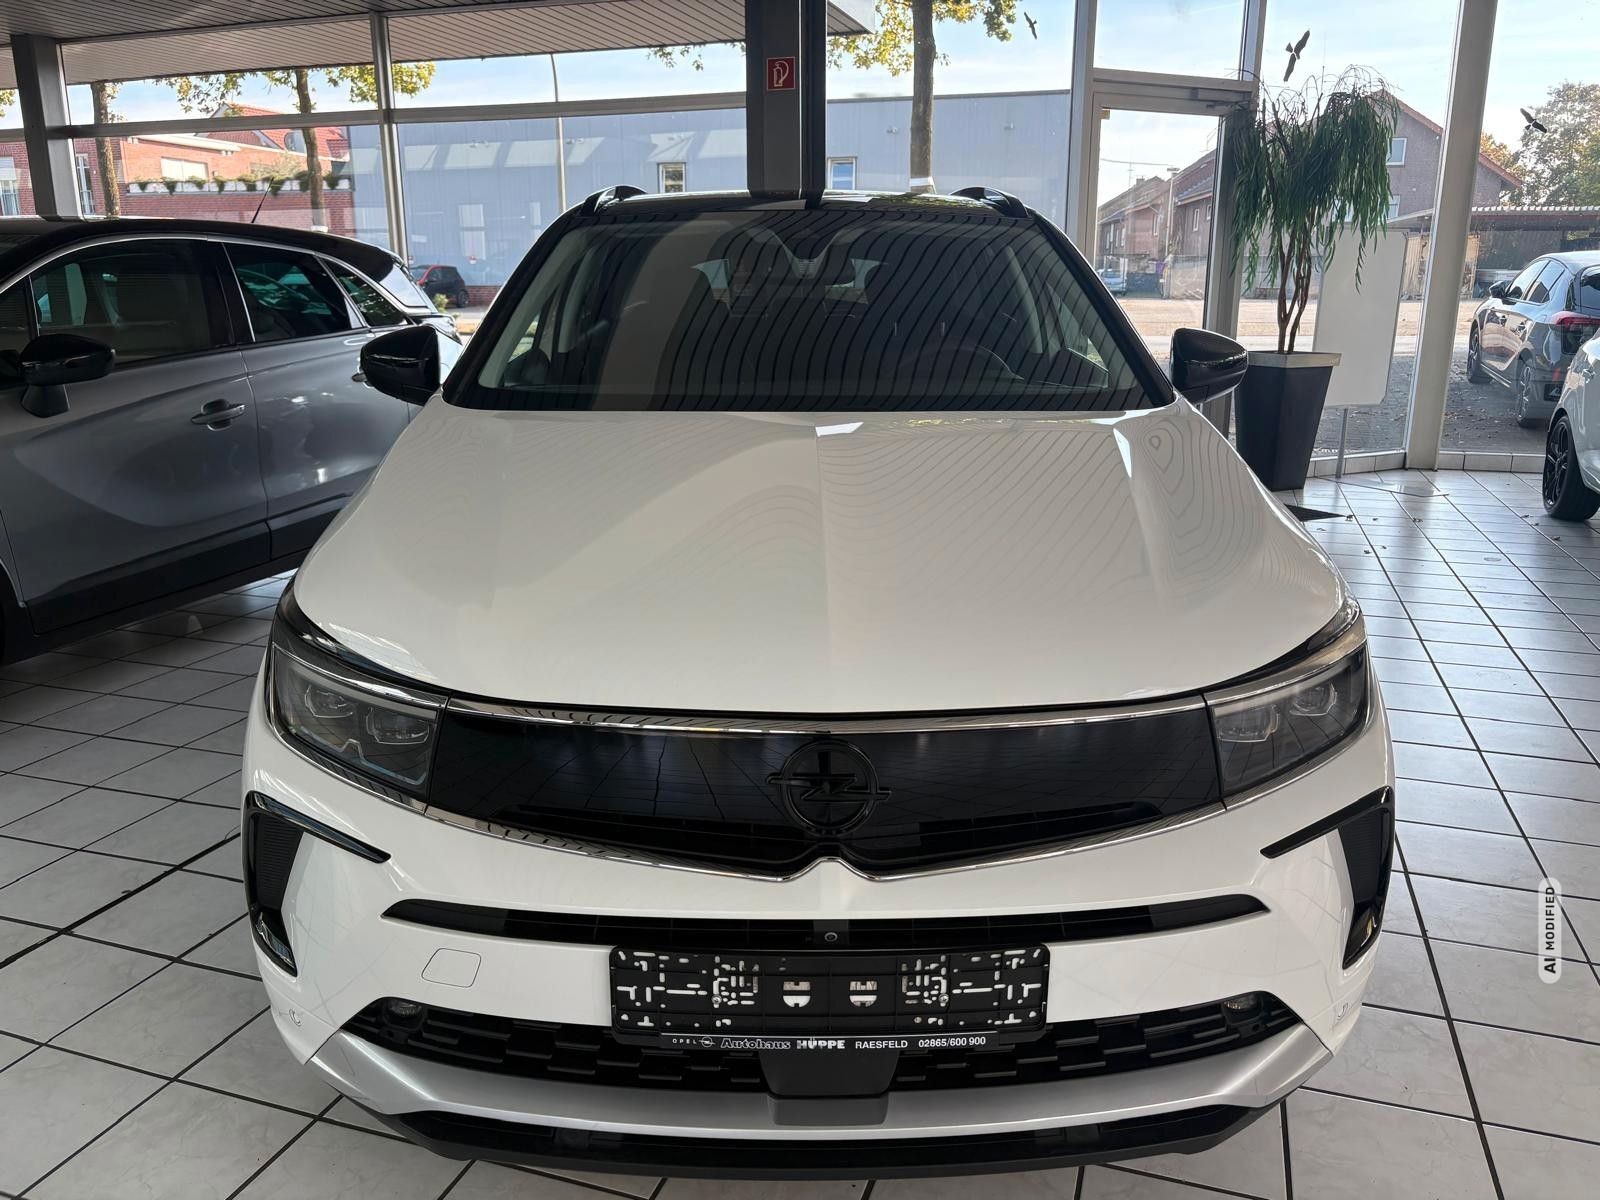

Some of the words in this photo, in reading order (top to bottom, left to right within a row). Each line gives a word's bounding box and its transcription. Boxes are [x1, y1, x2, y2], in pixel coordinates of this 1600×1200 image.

[720, 1037, 792, 1049] Autohaus
[796, 1037, 845, 1049] HÜPPE
[855, 1040, 908, 1049] RAESFELD
[918, 1037, 967, 1048] 02865/600
[968, 1036, 986, 1046] 900
